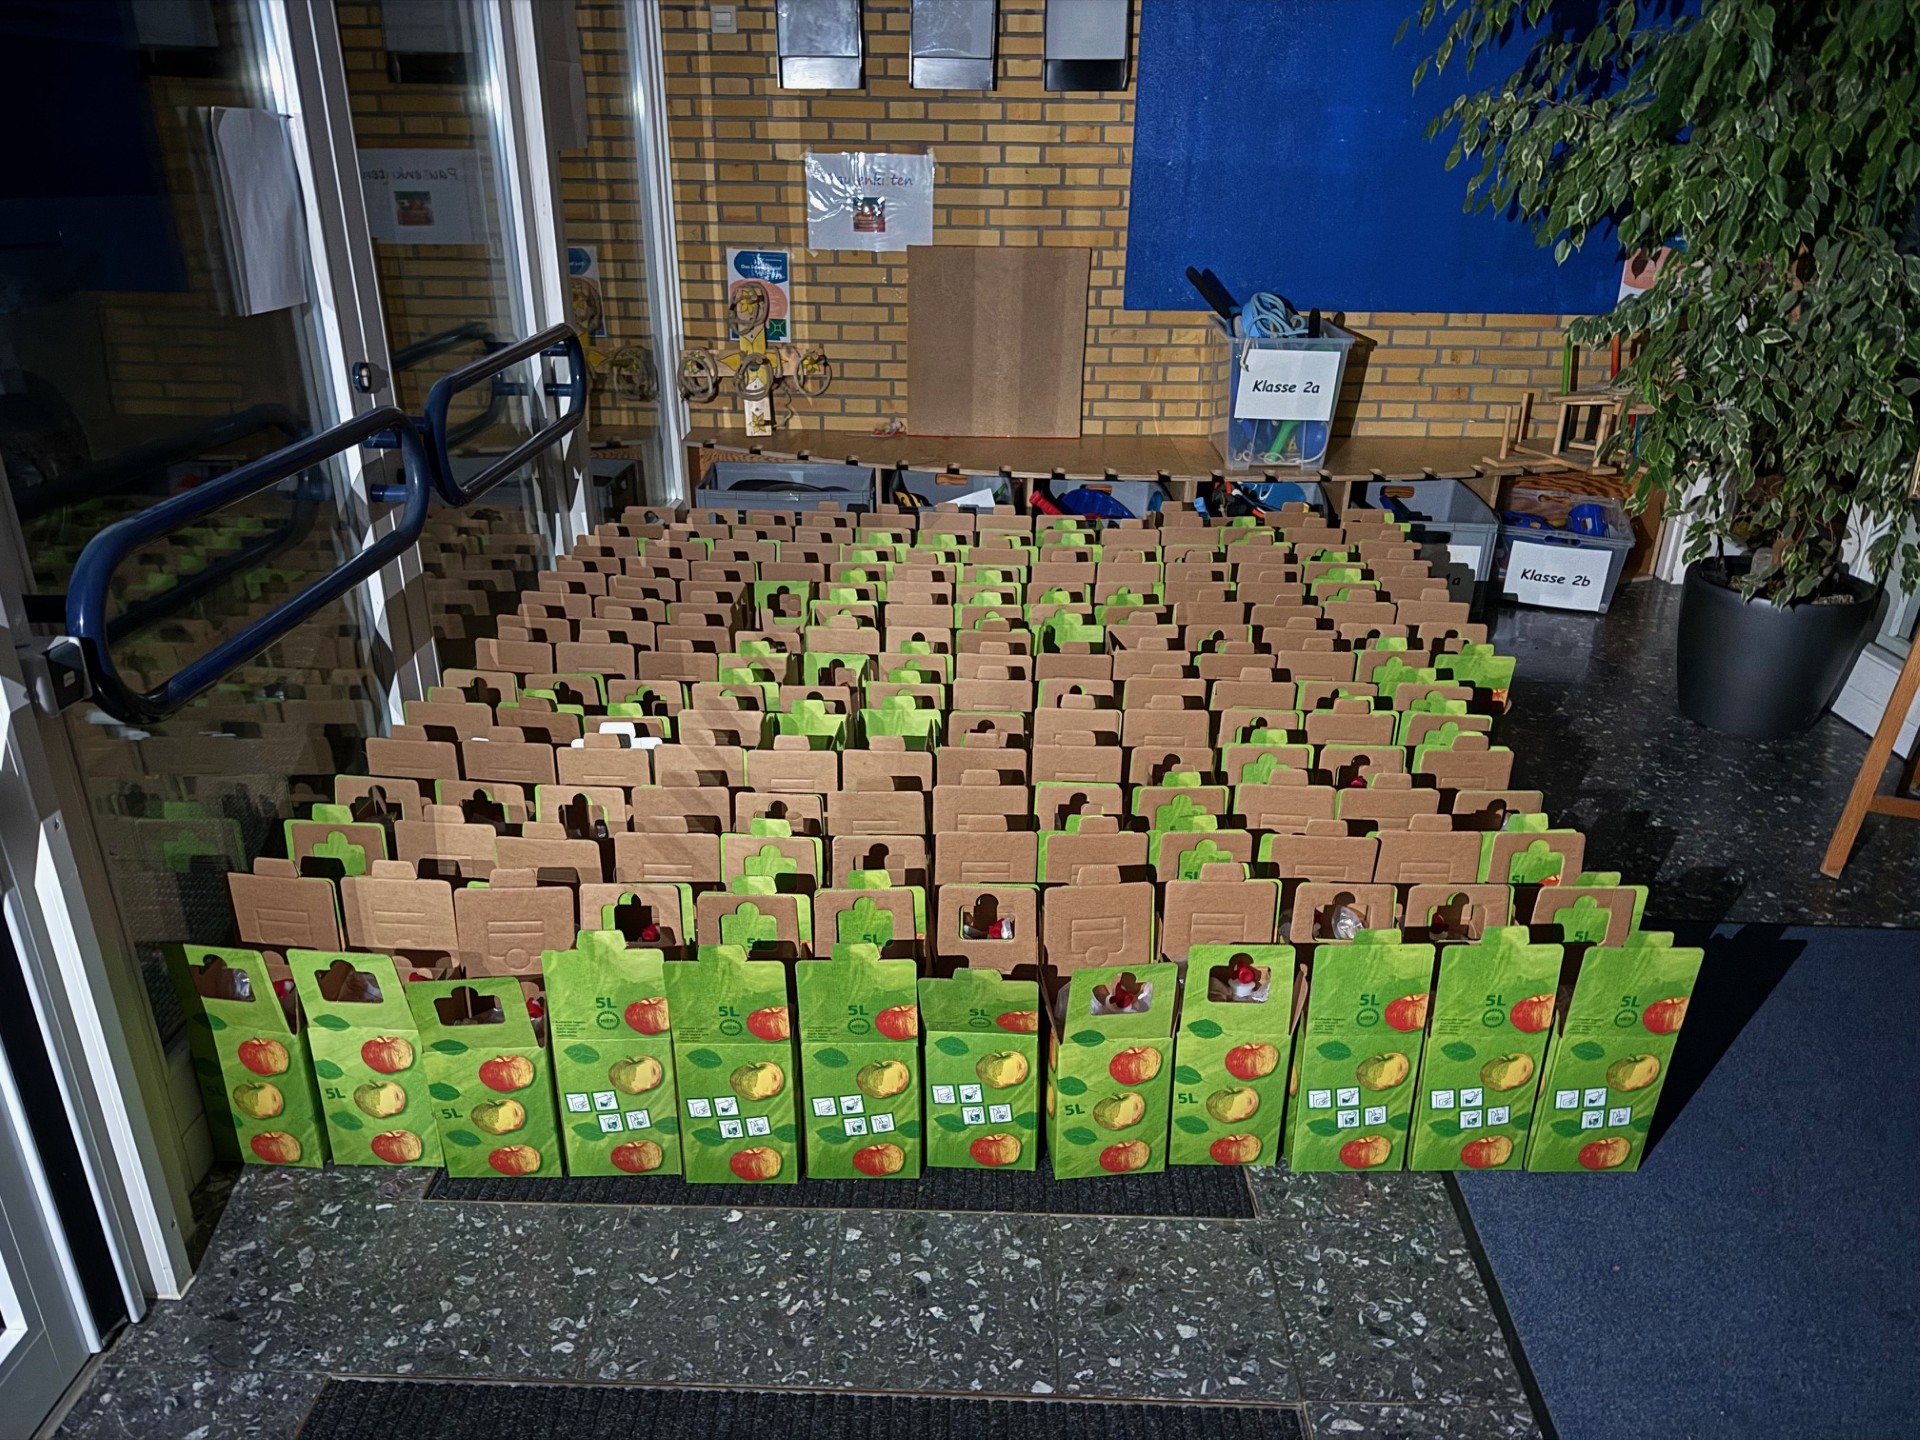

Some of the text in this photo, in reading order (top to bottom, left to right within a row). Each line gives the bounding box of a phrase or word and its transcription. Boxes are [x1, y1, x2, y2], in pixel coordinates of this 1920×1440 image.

[1252, 380, 1321, 393] Klasse 2a
[1520, 568, 1591, 587] Klasse 2b
[596, 997, 617, 1009] 5L
[1360, 994, 1380, 1006] 5L
[1485, 995, 1506, 1006] 5L
[1621, 996, 1640, 1007] 5L
[719, 1006, 740, 1017] 5L
[848, 1005, 869, 1016] 5L
[969, 1008, 991, 1017] 5L
[325, 1087, 346, 1100] 5L
[1178, 1092, 1199, 1104] 5L
[441, 1107, 464, 1120] 5L
[1064, 1103, 1086, 1116] 5L
